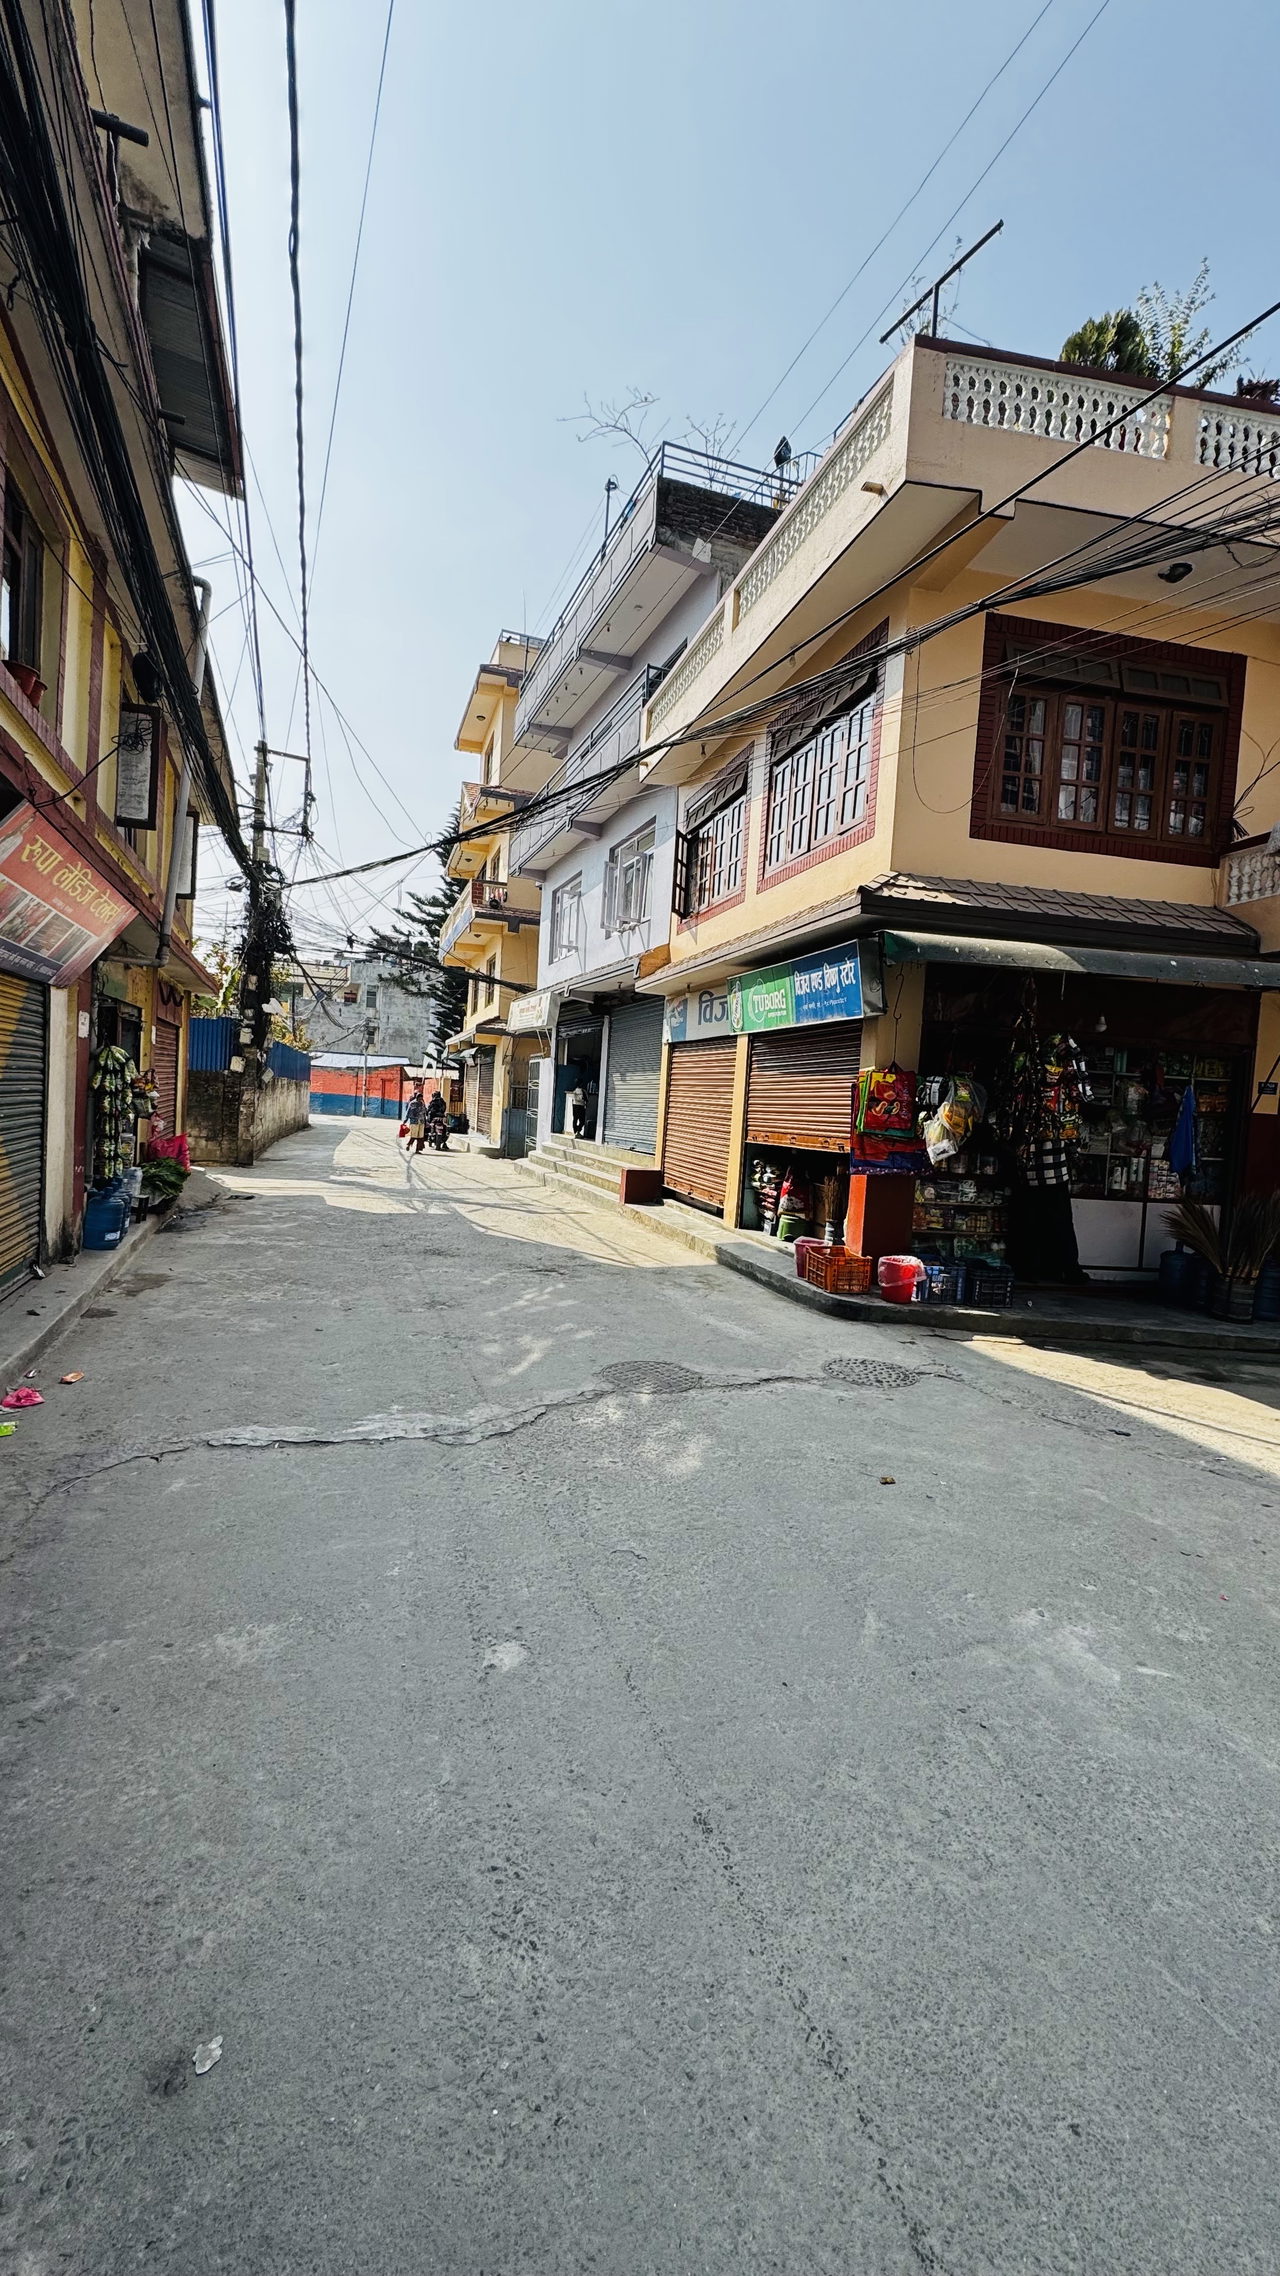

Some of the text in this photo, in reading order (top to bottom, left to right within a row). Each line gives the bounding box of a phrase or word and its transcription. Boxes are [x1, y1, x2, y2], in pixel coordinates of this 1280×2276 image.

[21, 834, 63, 875] रूपा
[52, 862, 99, 904] लेडिज
[753, 988, 786, 1013] TUBORG
